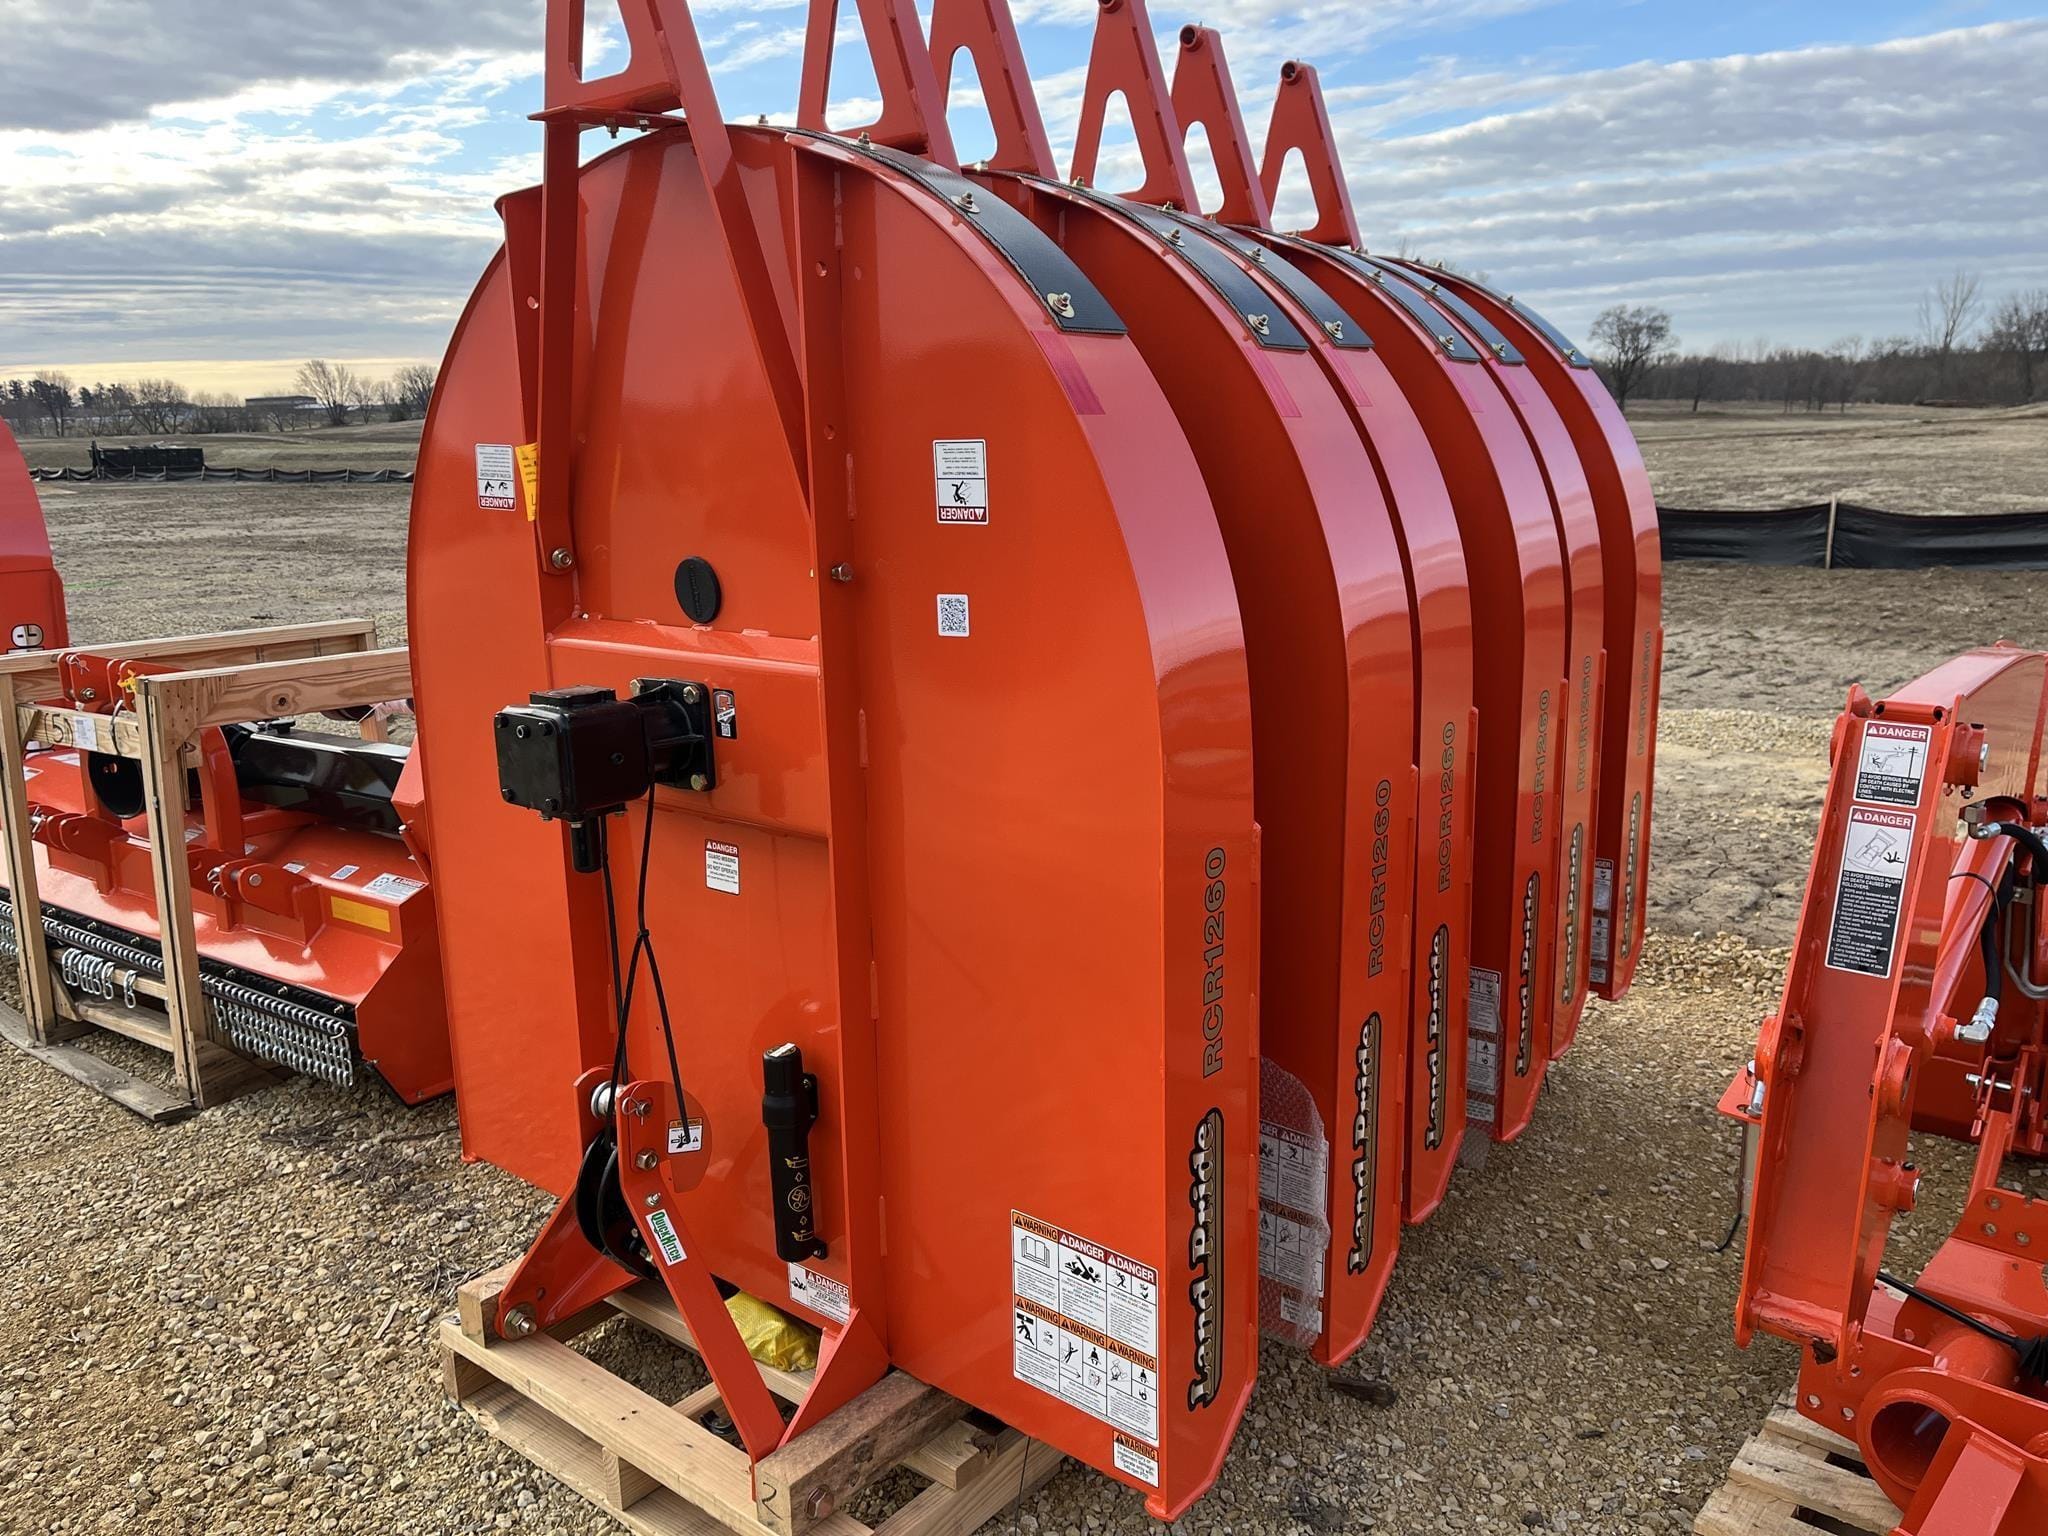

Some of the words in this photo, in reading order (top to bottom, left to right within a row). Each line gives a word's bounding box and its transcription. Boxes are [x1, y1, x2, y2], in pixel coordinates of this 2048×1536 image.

[480, 497, 508, 508] DANGER
[940, 508, 974, 520] DANGER
[1879, 727, 1926, 740] DANGER
[1532, 690, 1550, 843] RCR1260
[1438, 722, 1456, 893] RCR1260
[1864, 812, 1911, 827] DANGER
[712, 842, 737, 854] DANGER
[1368, 778, 1391, 978] RCR1260
[1521, 878, 1534, 978] Pride
[1203, 847, 1226, 1078] RCR1260
[1428, 930, 1443, 1042] Pride
[1515, 987, 1530, 1076] Land
[1354, 1022, 1372, 1149] Pride
[1426, 1050, 1440, 1150] Land
[1261, 1124, 1278, 1136] GER
[1190, 1117, 1215, 1268] Pride
[1348, 1158, 1369, 1274] Land
[1022, 1218, 1057, 1240] WARNING
[1069, 1238, 1105, 1260] DANGER
[1117, 1258, 1154, 1282] DANGER
[815, 1276, 849, 1296] DANGER
[1024, 1302, 1058, 1324] WARNING
[1070, 1321, 1104, 1346] WARNING
[1189, 1276, 1215, 1410] Land
[1117, 1344, 1154, 1370] WARNING
[1124, 1436, 1156, 1460] WARNING
